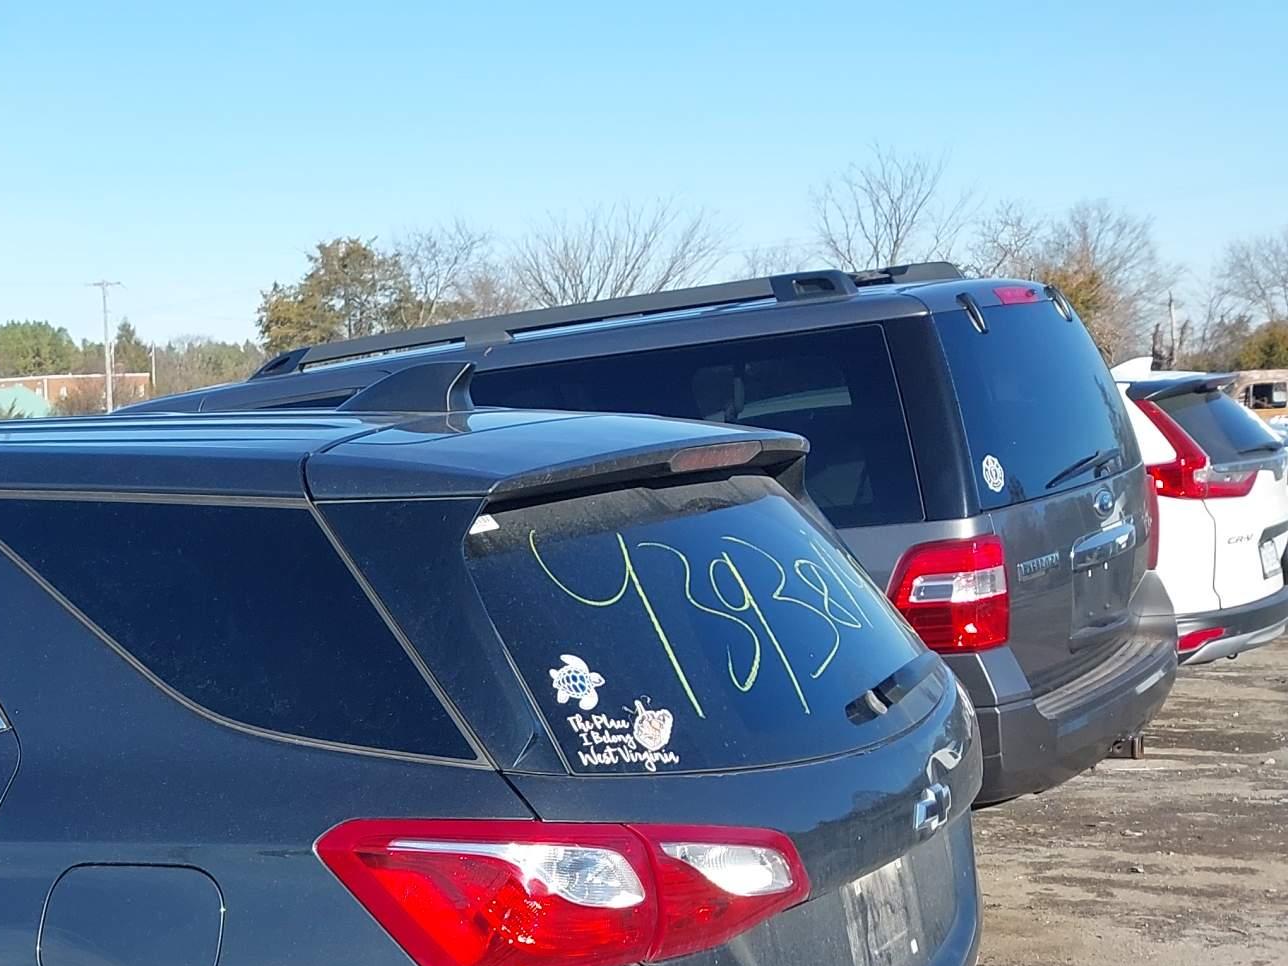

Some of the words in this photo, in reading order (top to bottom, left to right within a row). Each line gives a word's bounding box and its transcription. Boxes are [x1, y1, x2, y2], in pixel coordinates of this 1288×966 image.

[566, 713, 594, 733] The
[578, 732, 593, 746] I
[590, 730, 637, 750] Belong
[577, 745, 619, 766] West
[617, 746, 680, 772] Virginia
